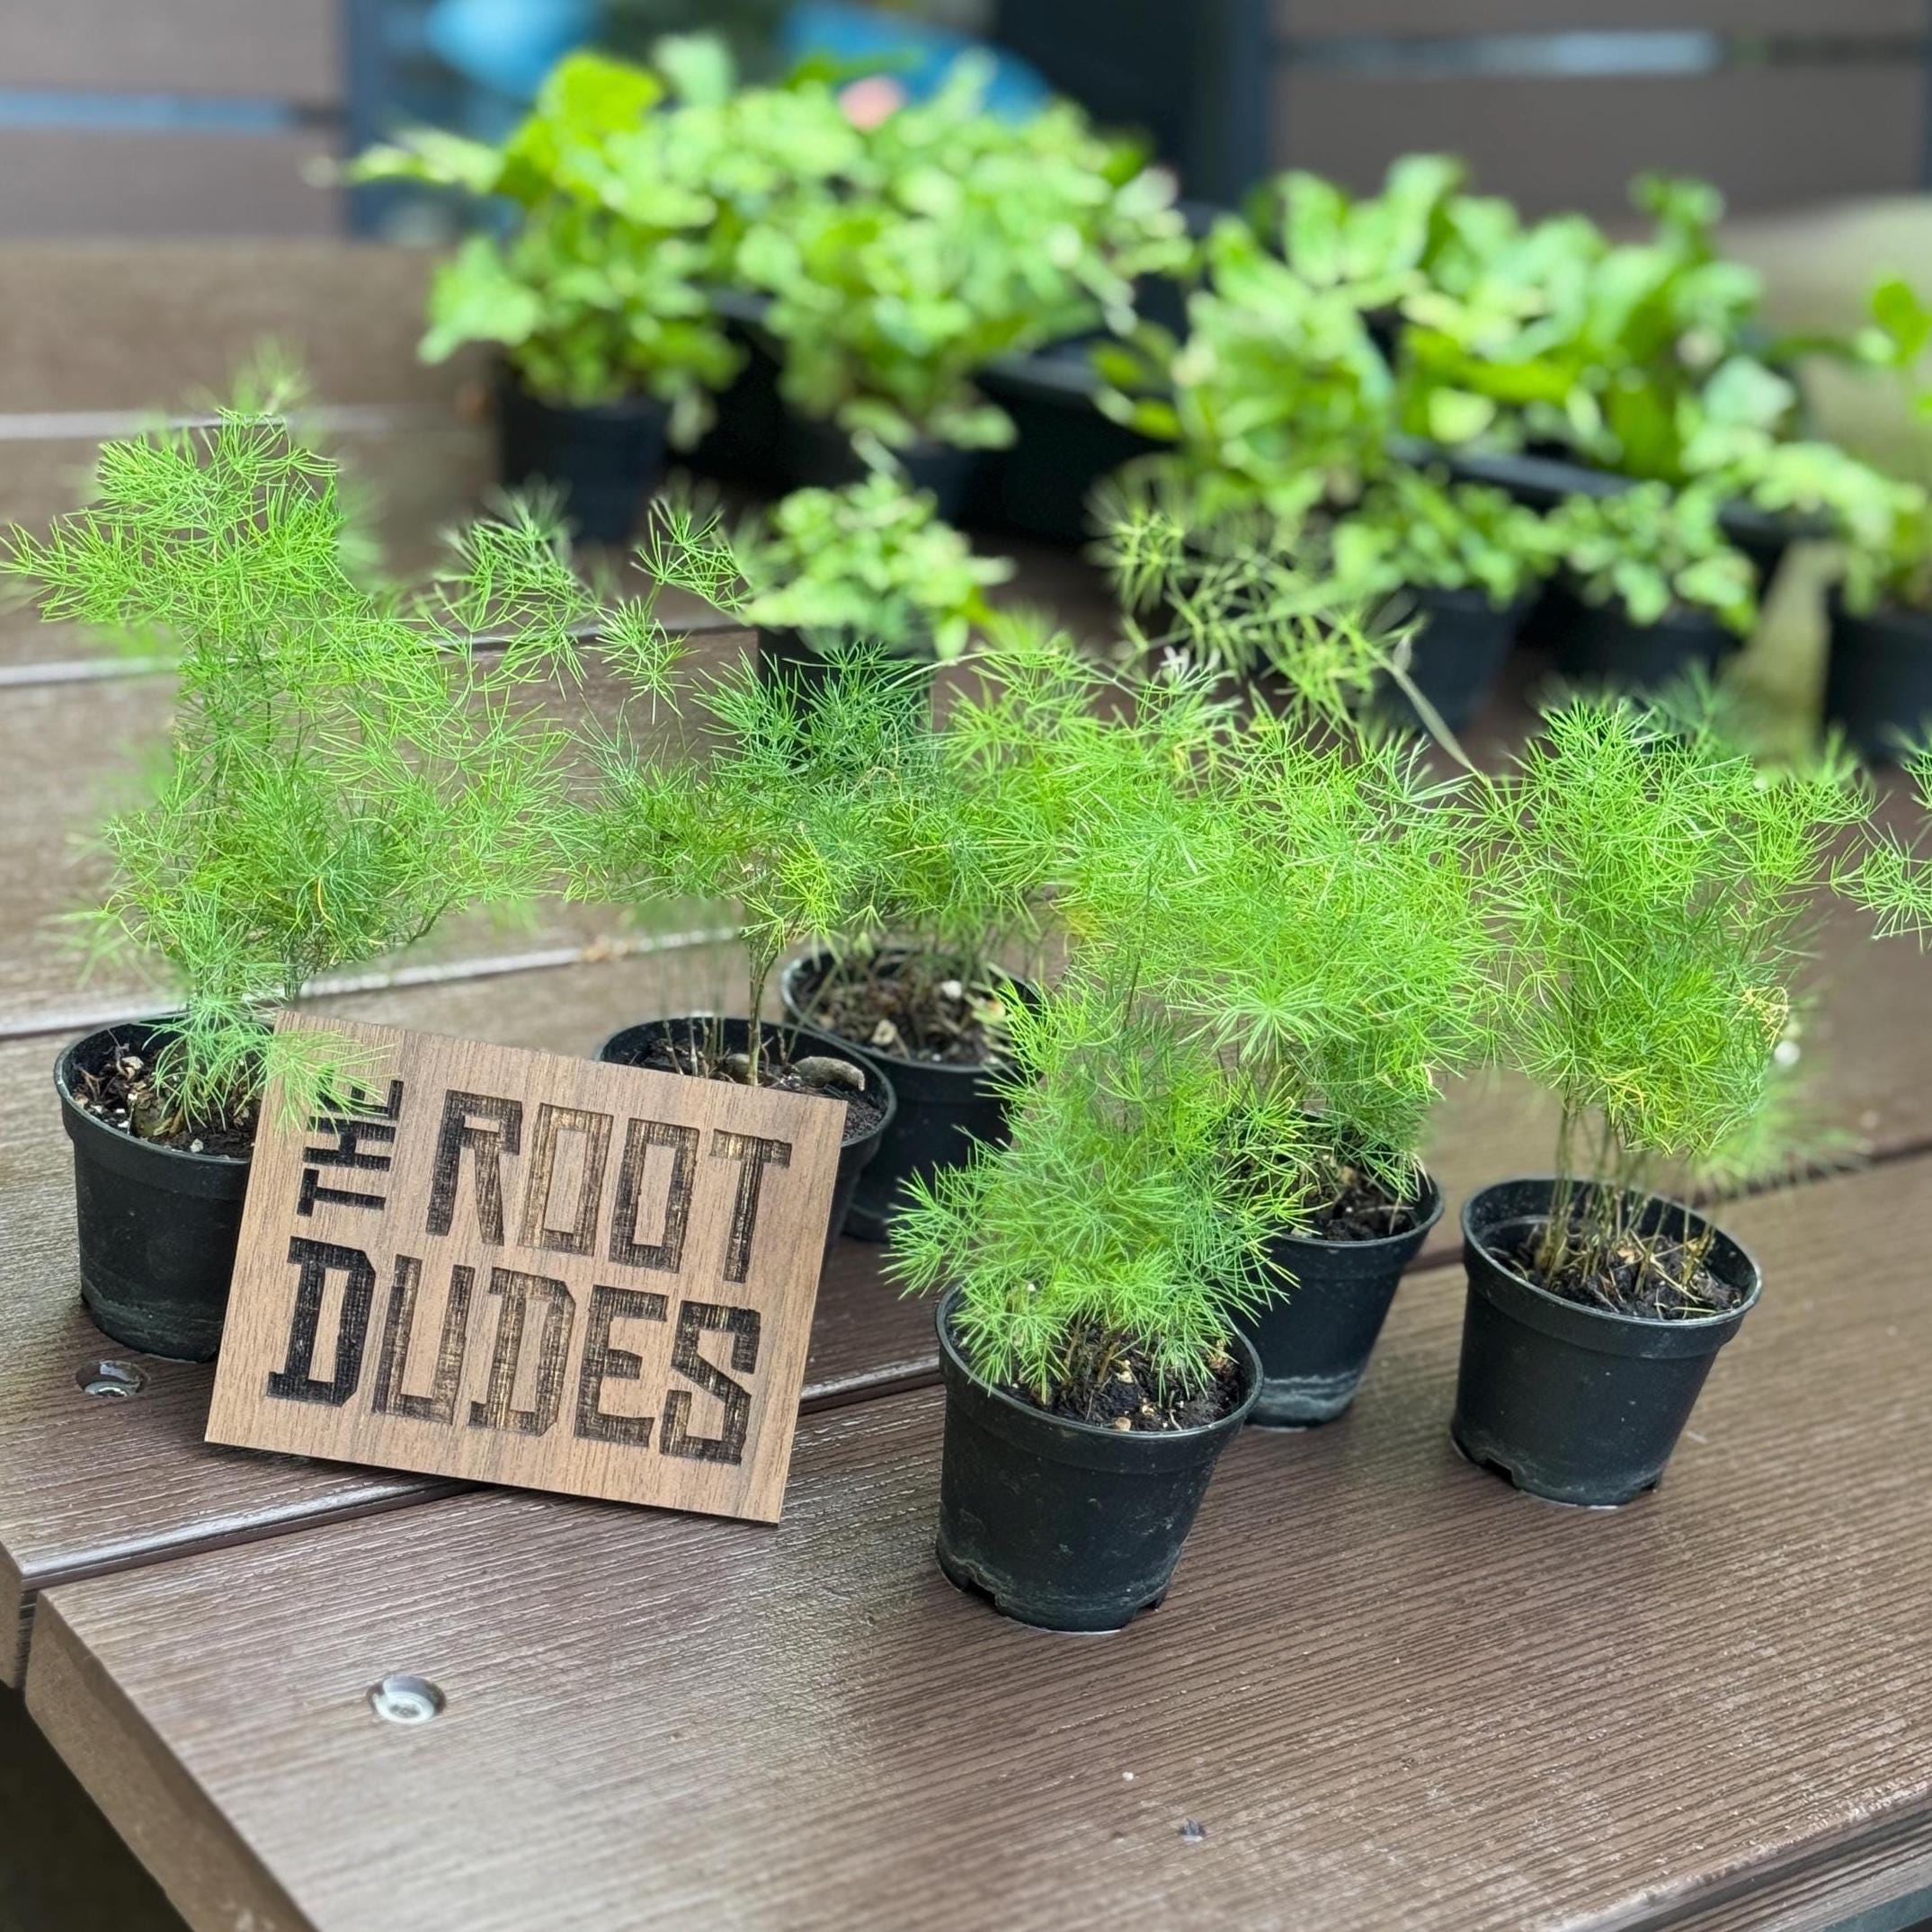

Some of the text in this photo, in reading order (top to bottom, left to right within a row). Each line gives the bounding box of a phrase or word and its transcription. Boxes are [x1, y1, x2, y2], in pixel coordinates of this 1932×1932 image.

[297, 1069, 404, 1216] THE
[426, 1090, 792, 1284] ROOT
[267, 1236, 761, 1465] DUDES
